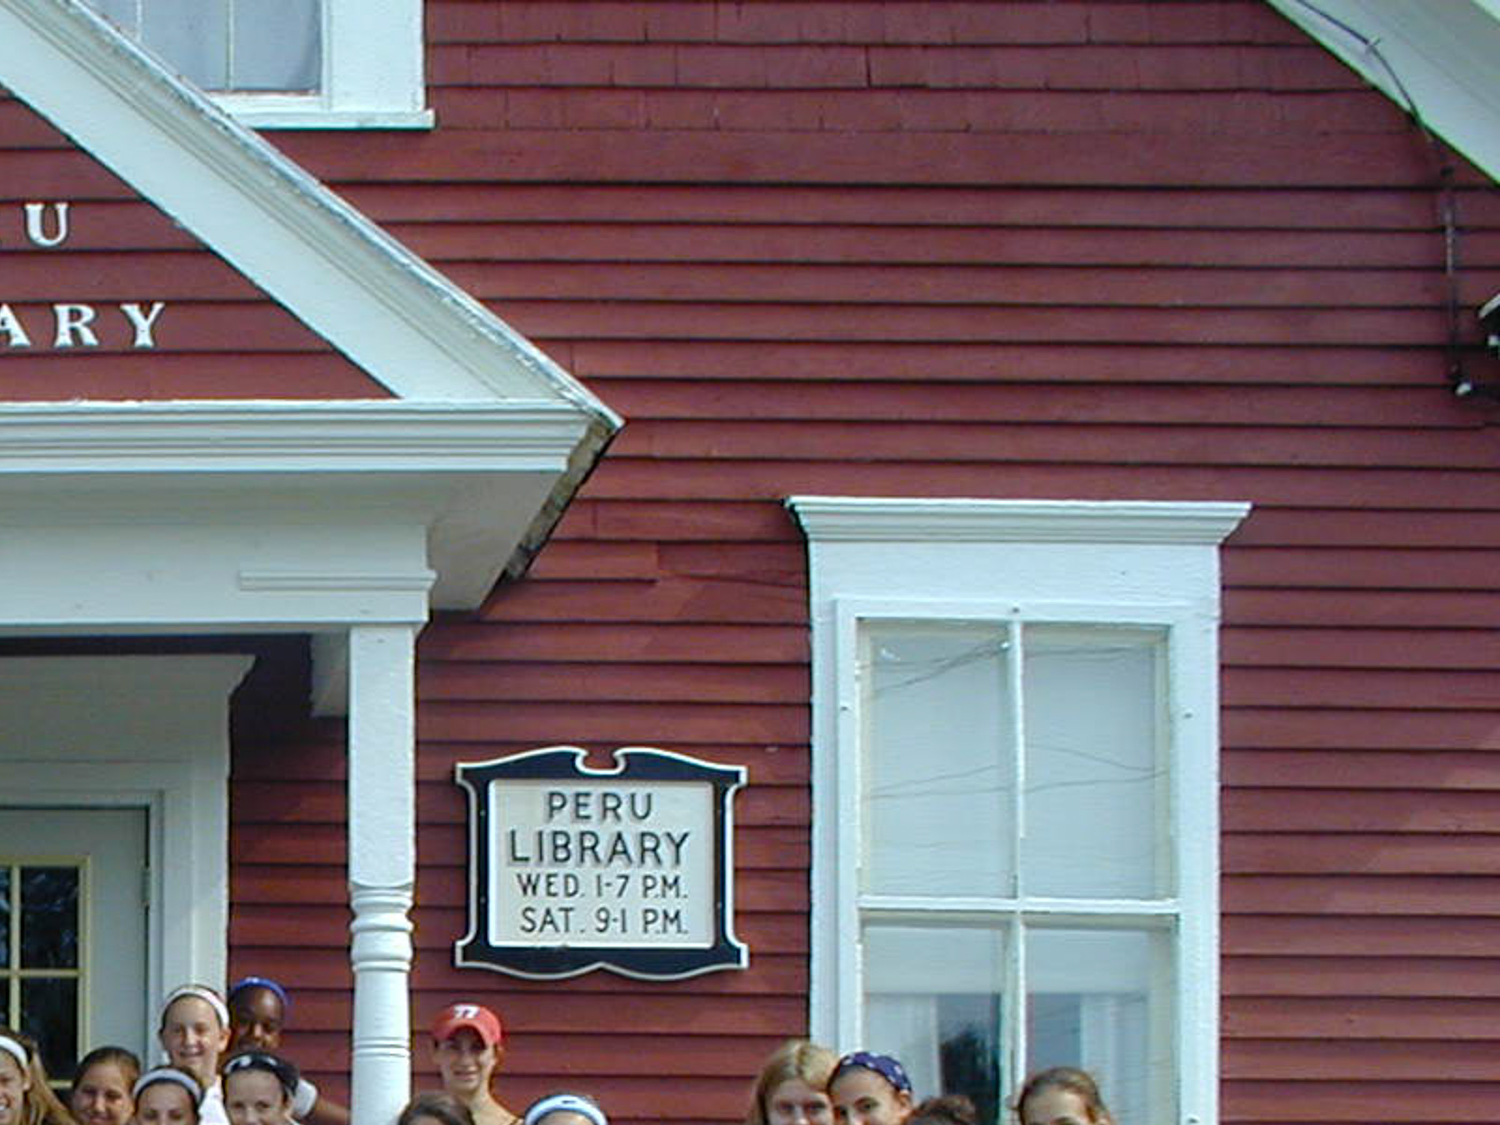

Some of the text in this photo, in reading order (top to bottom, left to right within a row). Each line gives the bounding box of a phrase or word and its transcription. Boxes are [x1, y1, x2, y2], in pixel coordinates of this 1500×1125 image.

[546, 791, 653, 821] PERU
[507, 830, 690, 864] LIBRARY
[516, 873, 689, 899] WED. 1-7 P.M.
[519, 907, 689, 934] SAT. 9-1 P.M.
